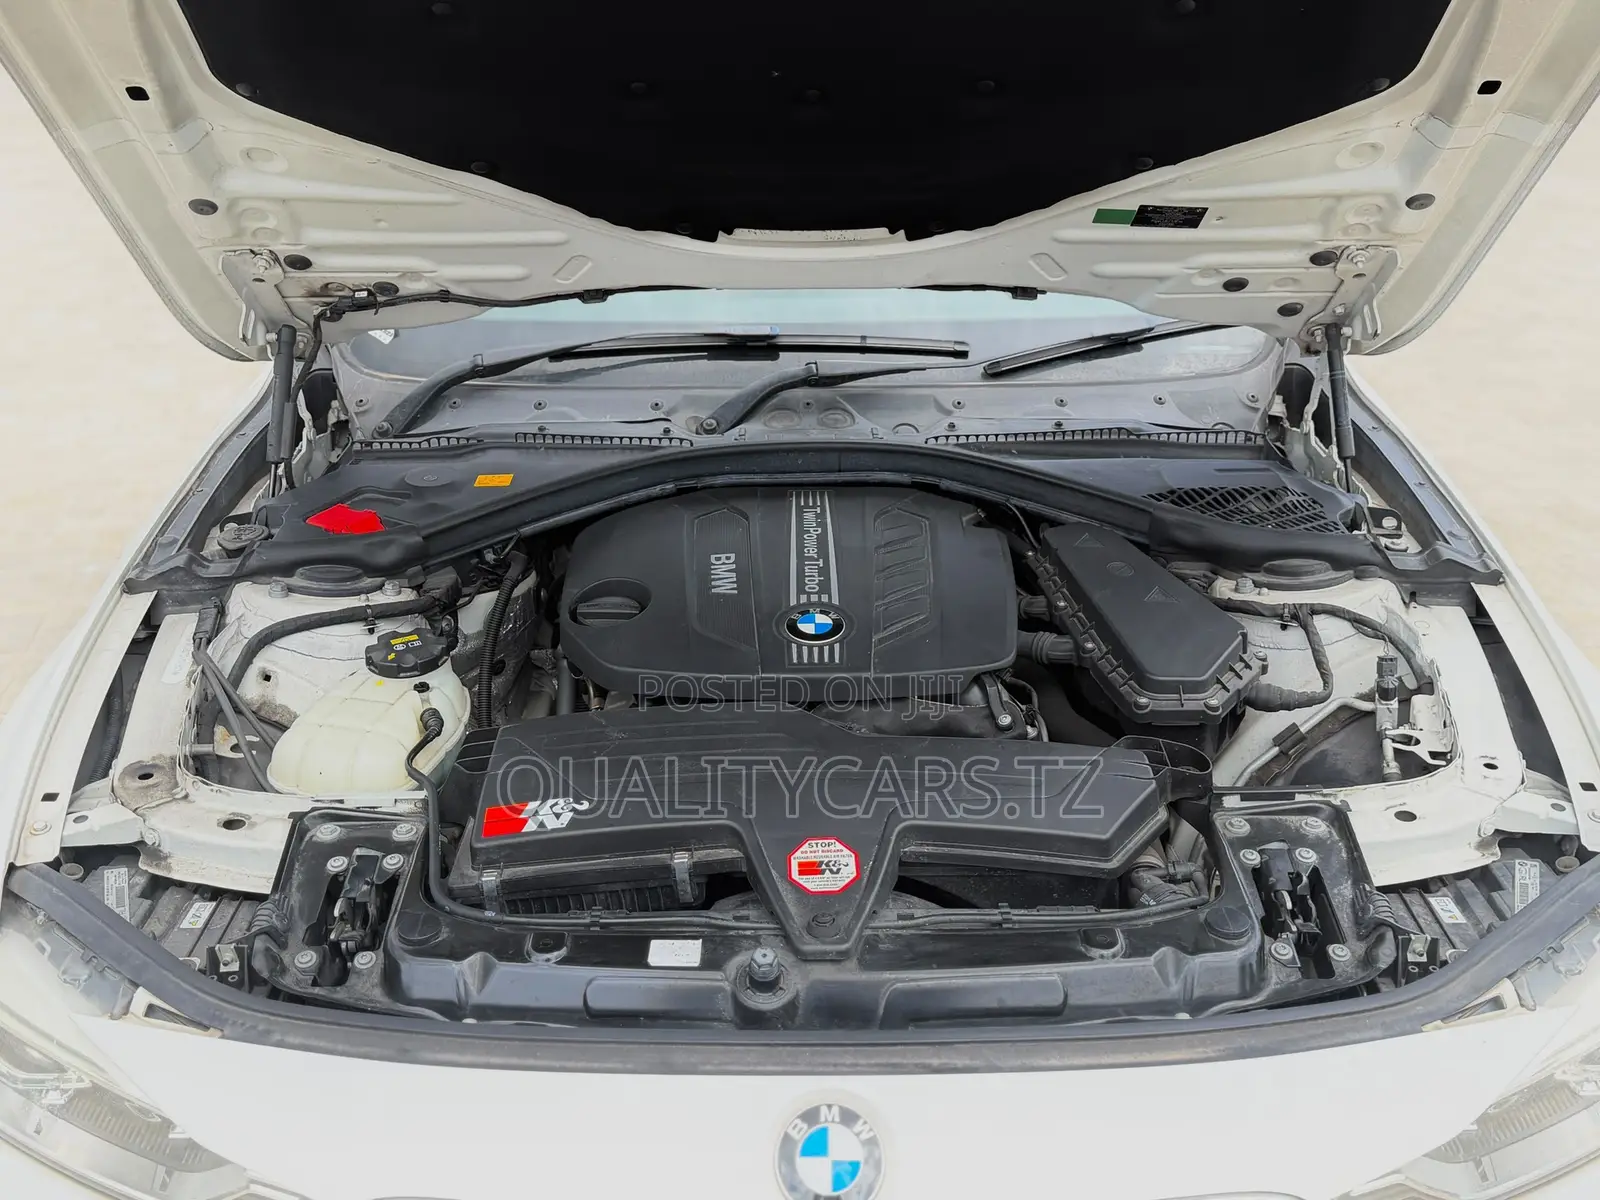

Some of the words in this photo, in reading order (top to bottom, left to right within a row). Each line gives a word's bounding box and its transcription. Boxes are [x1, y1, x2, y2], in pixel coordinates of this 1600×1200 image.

[710, 553, 738, 594] BMW
[790, 608, 840, 620] BMW
[520, 797, 590, 833] K&N
[786, 1104, 875, 1141] BMW
